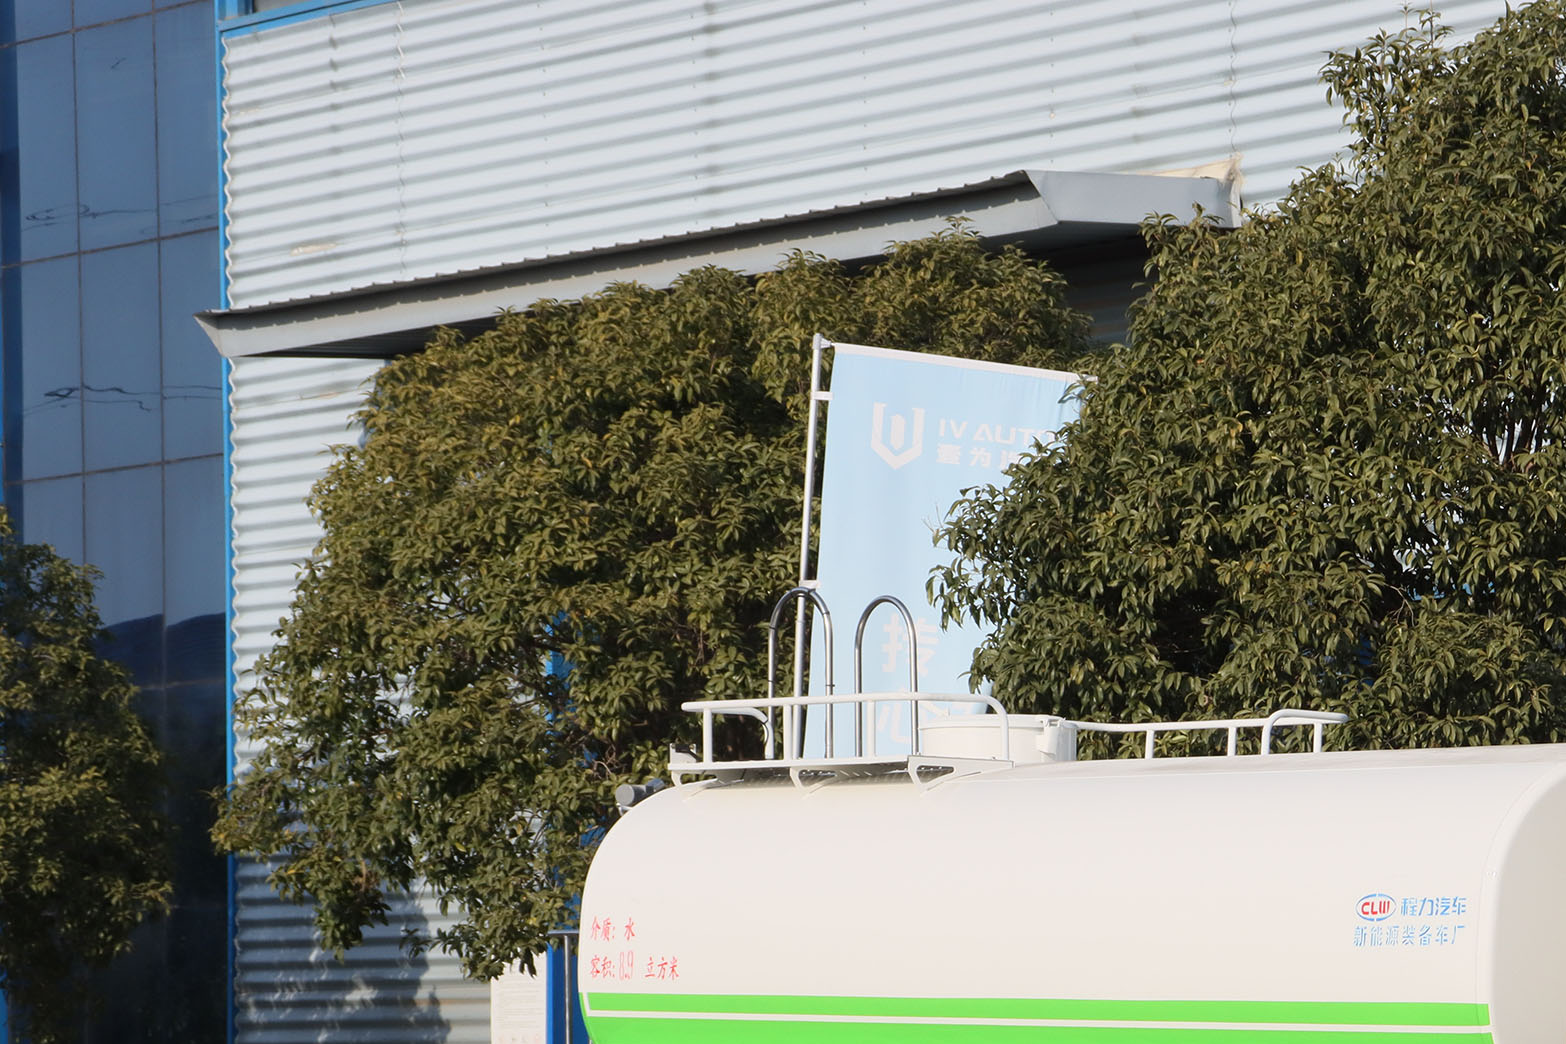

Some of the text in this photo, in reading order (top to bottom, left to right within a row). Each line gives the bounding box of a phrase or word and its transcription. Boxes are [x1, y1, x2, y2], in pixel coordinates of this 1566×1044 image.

[1400, 896, 1467, 917] 程力汽车
[624, 917, 636, 941] 水
[644, 956, 680, 980] 立方米
